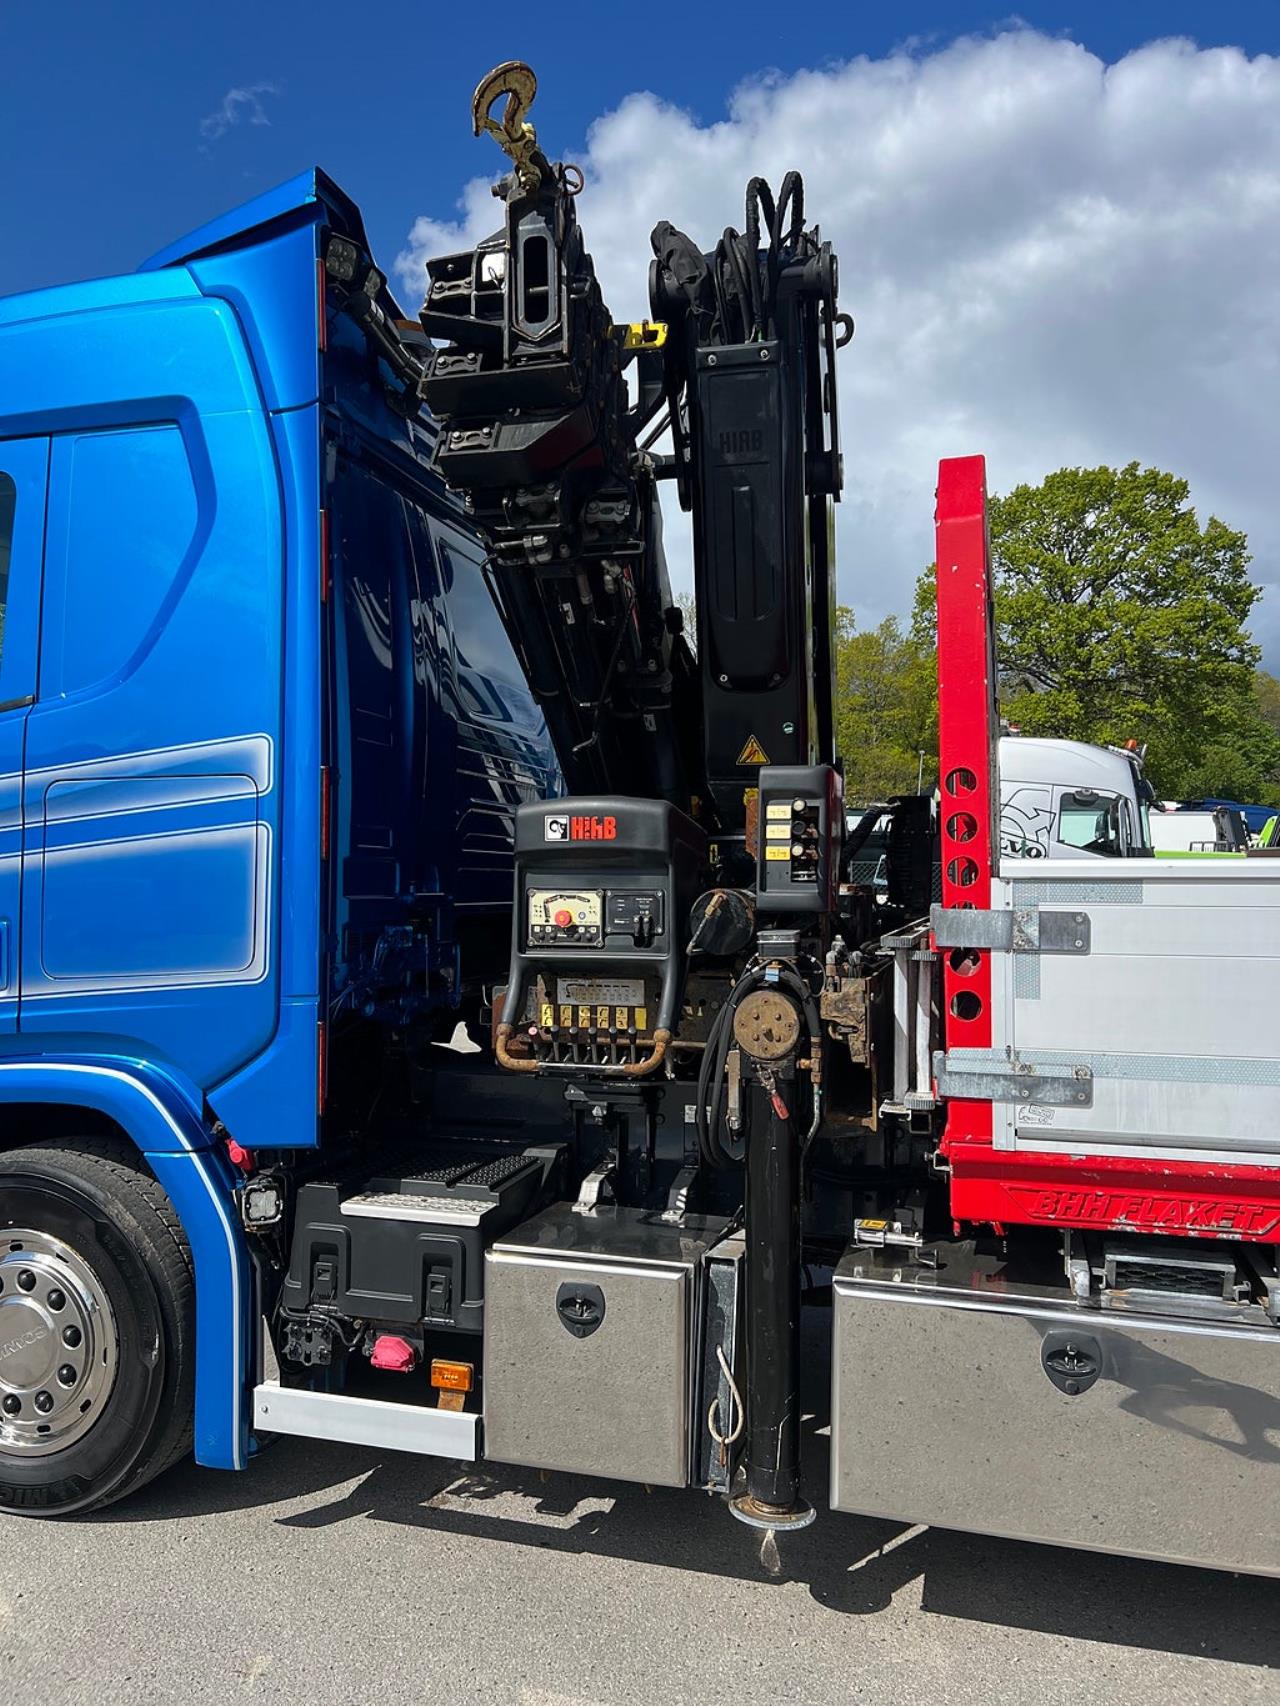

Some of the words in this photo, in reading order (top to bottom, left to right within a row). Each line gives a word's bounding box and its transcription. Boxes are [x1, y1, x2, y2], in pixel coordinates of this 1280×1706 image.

[720, 430, 762, 453] HIAB
[1032, 1191, 1110, 1219] BHH
[1115, 1197, 1265, 1229] FLAKET
